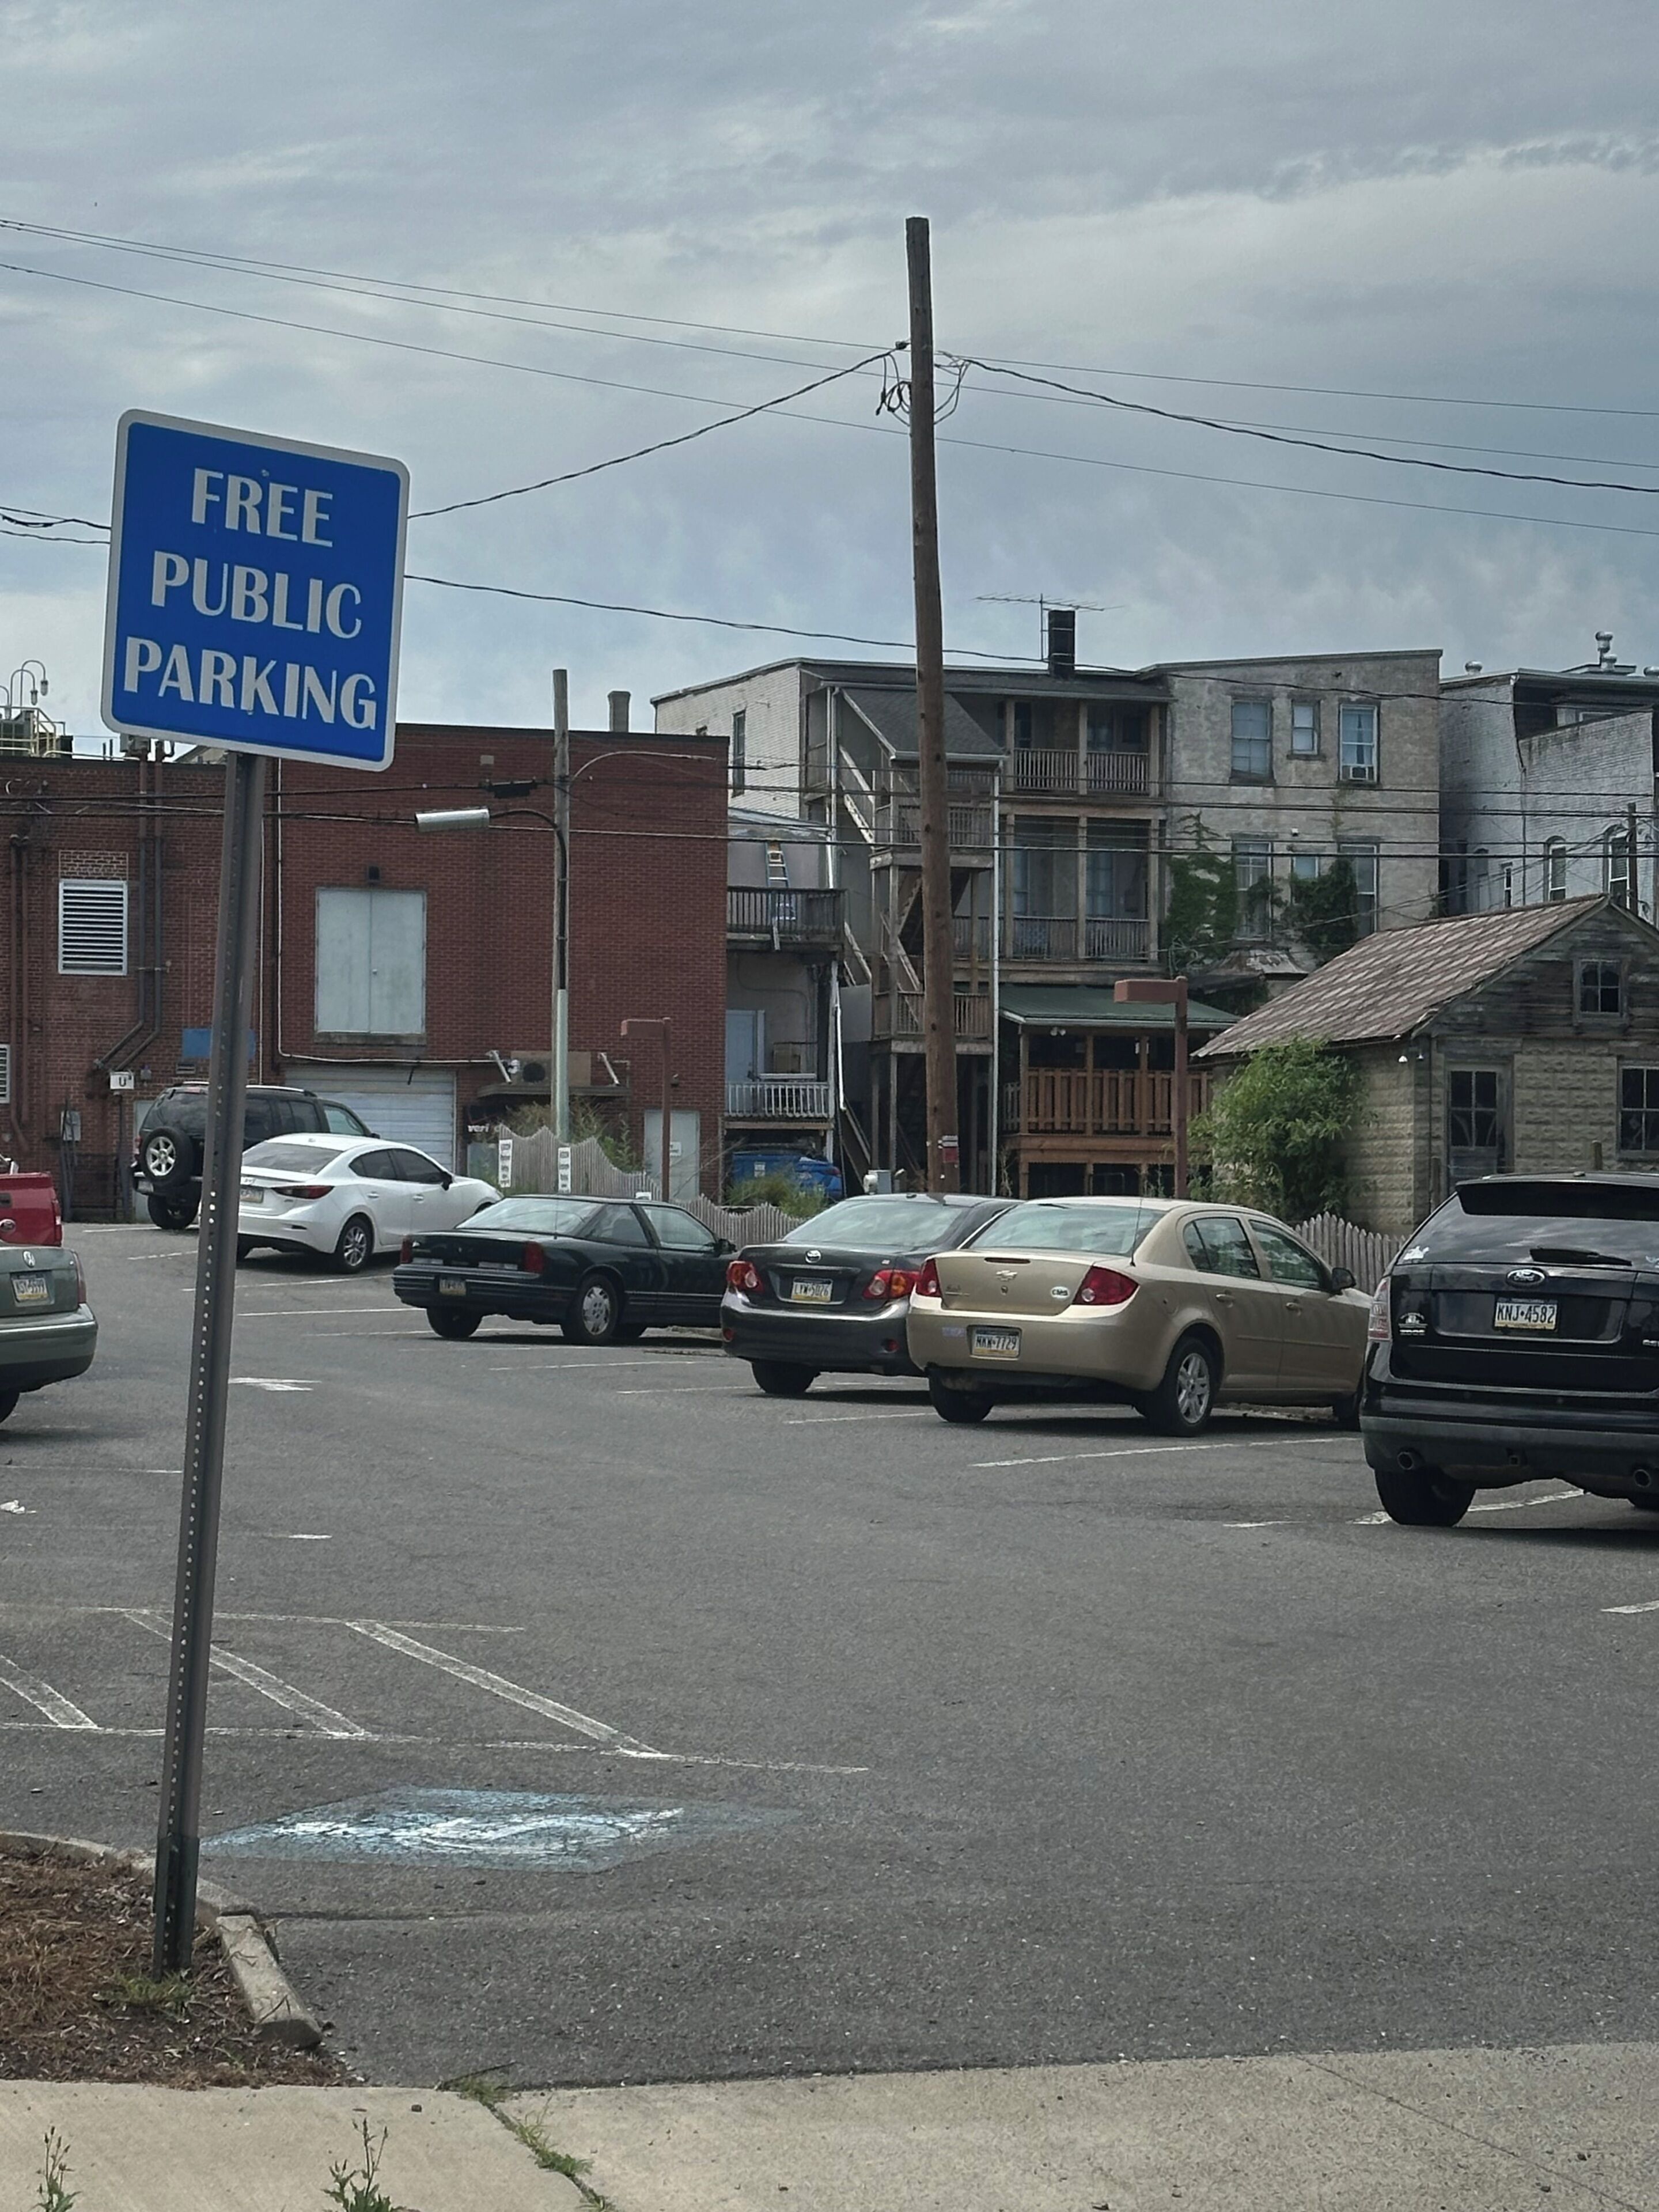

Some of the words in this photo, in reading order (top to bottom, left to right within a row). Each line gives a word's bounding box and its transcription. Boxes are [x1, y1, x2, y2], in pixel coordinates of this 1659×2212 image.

[191, 467, 333, 548] FREE
[151, 550, 362, 639] PUBLIC
[123, 636, 377, 730] PARKING
